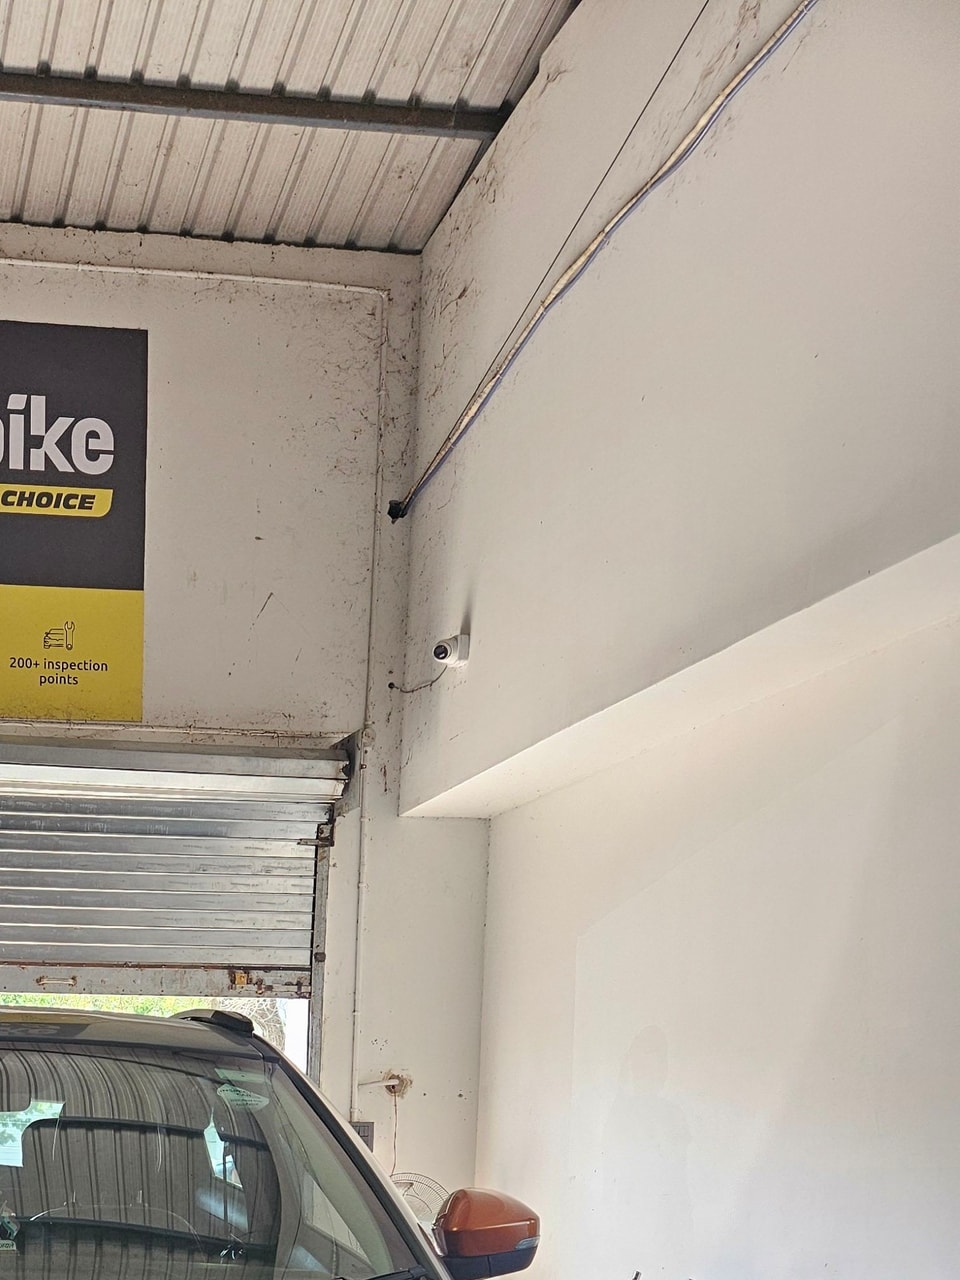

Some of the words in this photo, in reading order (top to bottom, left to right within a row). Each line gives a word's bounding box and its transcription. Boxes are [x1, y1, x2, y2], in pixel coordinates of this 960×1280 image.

[1, 490, 96, 511] CHOICE
[9, 657, 40, 669] 200+
[43, 658, 109, 674] inspection
[39, 673, 80, 686] points
